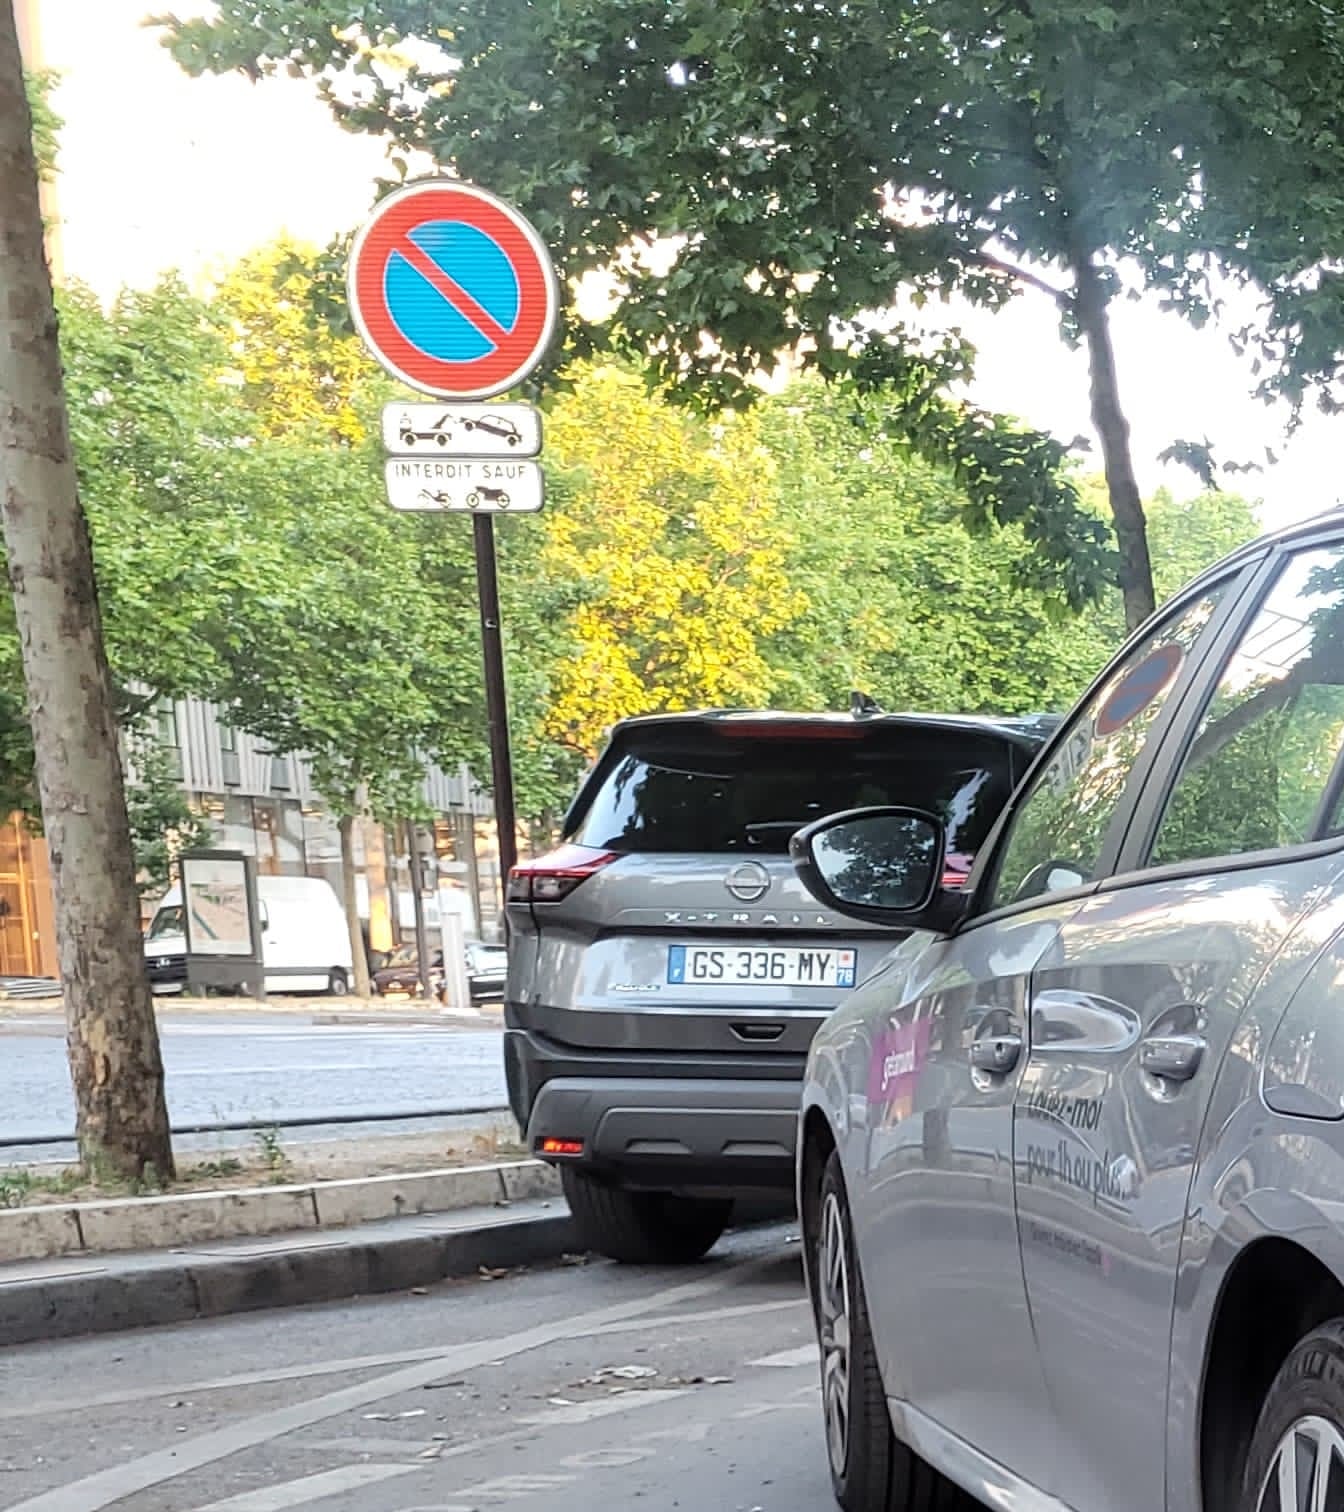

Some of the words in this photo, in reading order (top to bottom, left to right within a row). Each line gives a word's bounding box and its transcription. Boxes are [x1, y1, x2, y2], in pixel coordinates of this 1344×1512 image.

[395, 463, 472, 479] INTERDIT
[481, 463, 526, 479] SAUF
[692, 951, 832, 982] GS-336-MY
